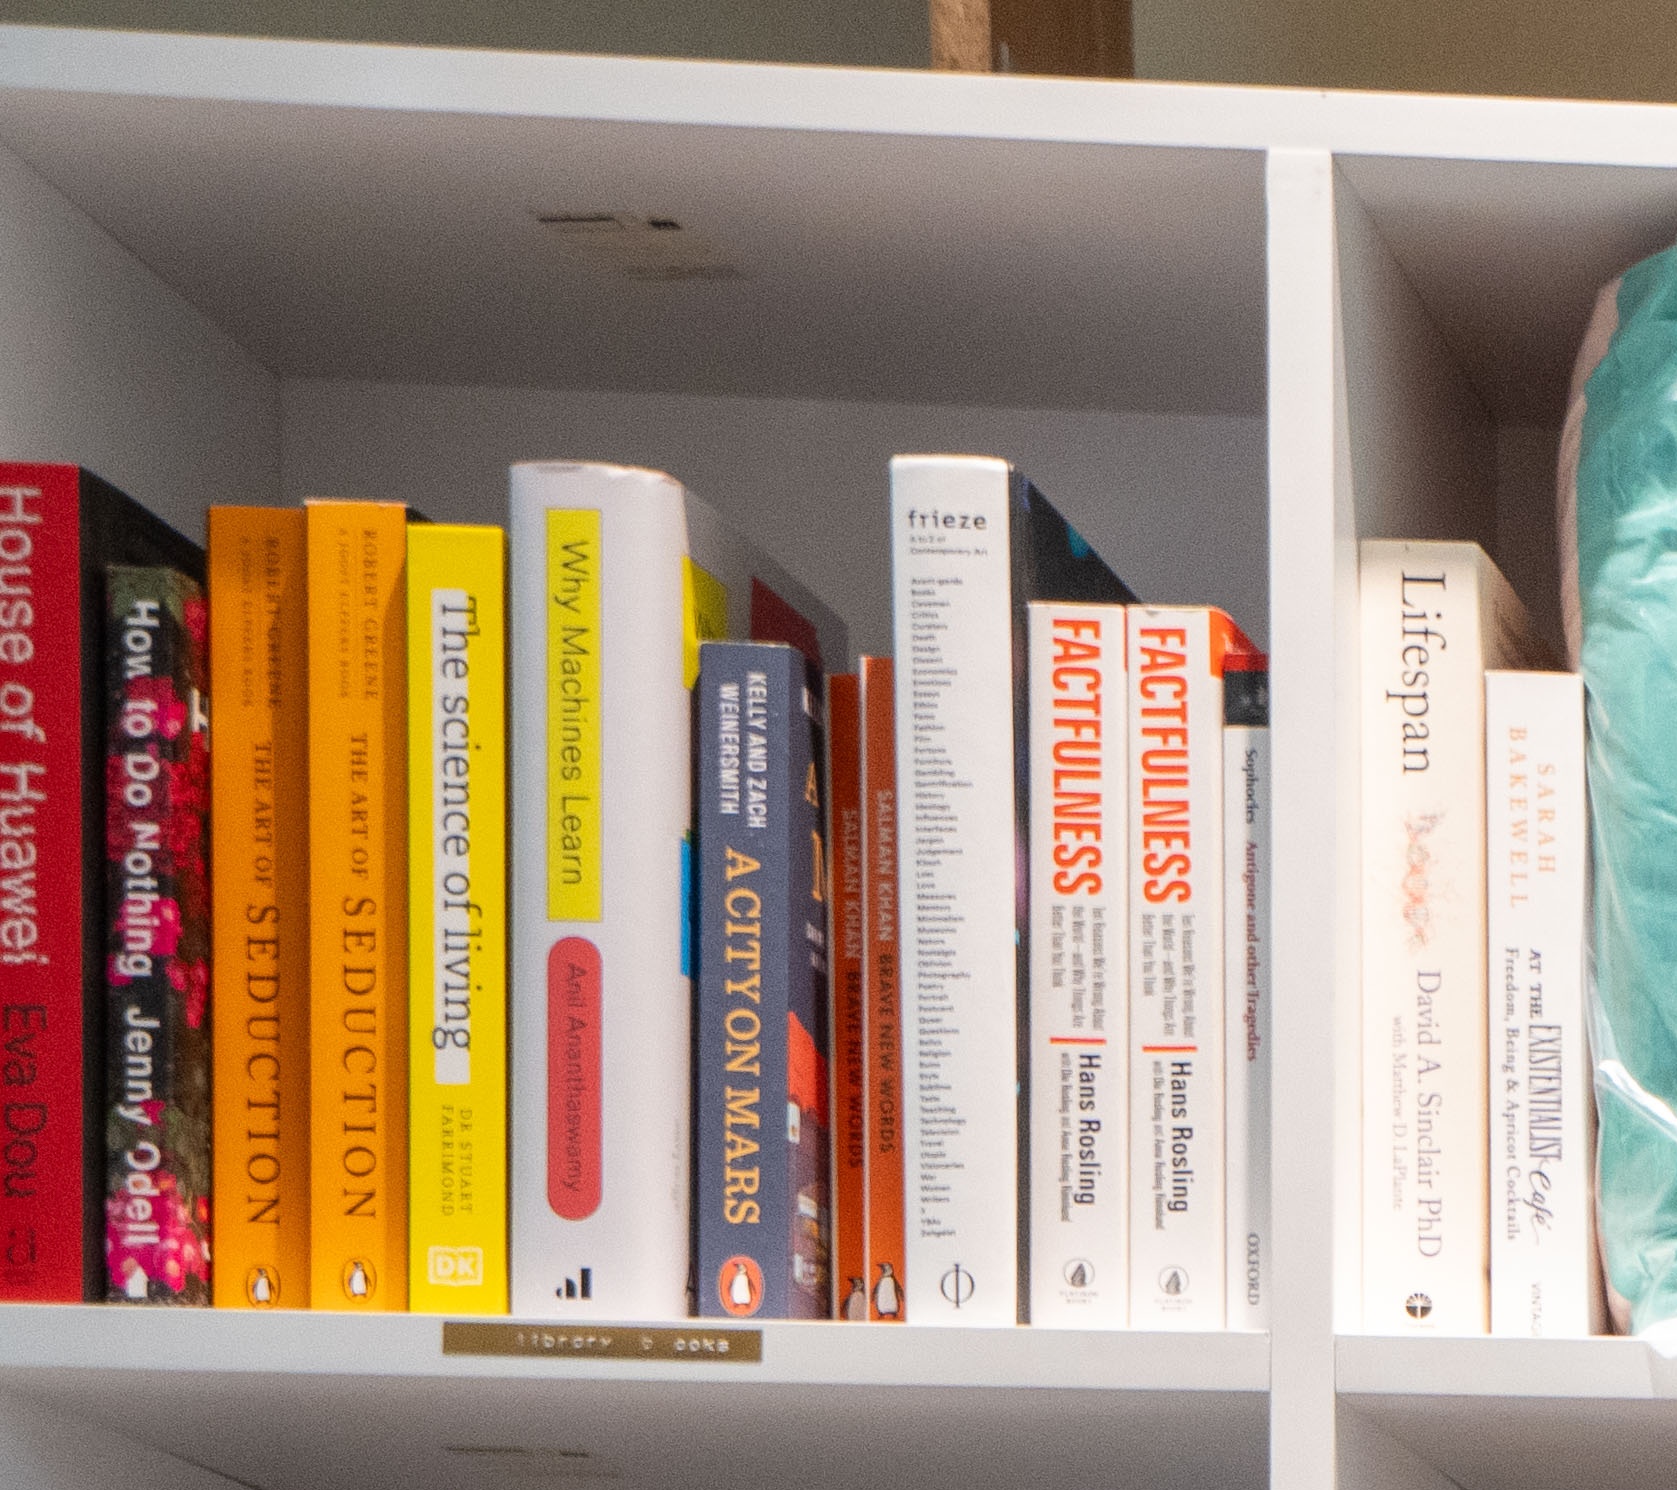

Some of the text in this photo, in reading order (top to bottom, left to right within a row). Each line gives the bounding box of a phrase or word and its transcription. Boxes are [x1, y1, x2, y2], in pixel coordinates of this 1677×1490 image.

[907, 511, 988, 530] frieze
[0, 486, 49, 966] House of Huawei
[118, 600, 160, 978] How to Do Nothing
[554, 539, 591, 885] Why Machines Learn
[1052, 618, 1101, 896] FACTFULNESS
[1139, 628, 1191, 904] FACTFULNESS
[1385, 571, 1447, 775] Lifespan
[432, 596, 482, 1052] The science of living
[342, 734, 377, 1219] THE ART OF SEDUCTION
[724, 847, 762, 1225] A CITY ON MARS
[1078, 1054, 1101, 1111] Hans
[1416, 969, 1443, 1258] David A. Sinclair PhD
[119, 1006, 160, 1245] Jenny Odell
[1074, 1118, 1103, 1206] Rosling
